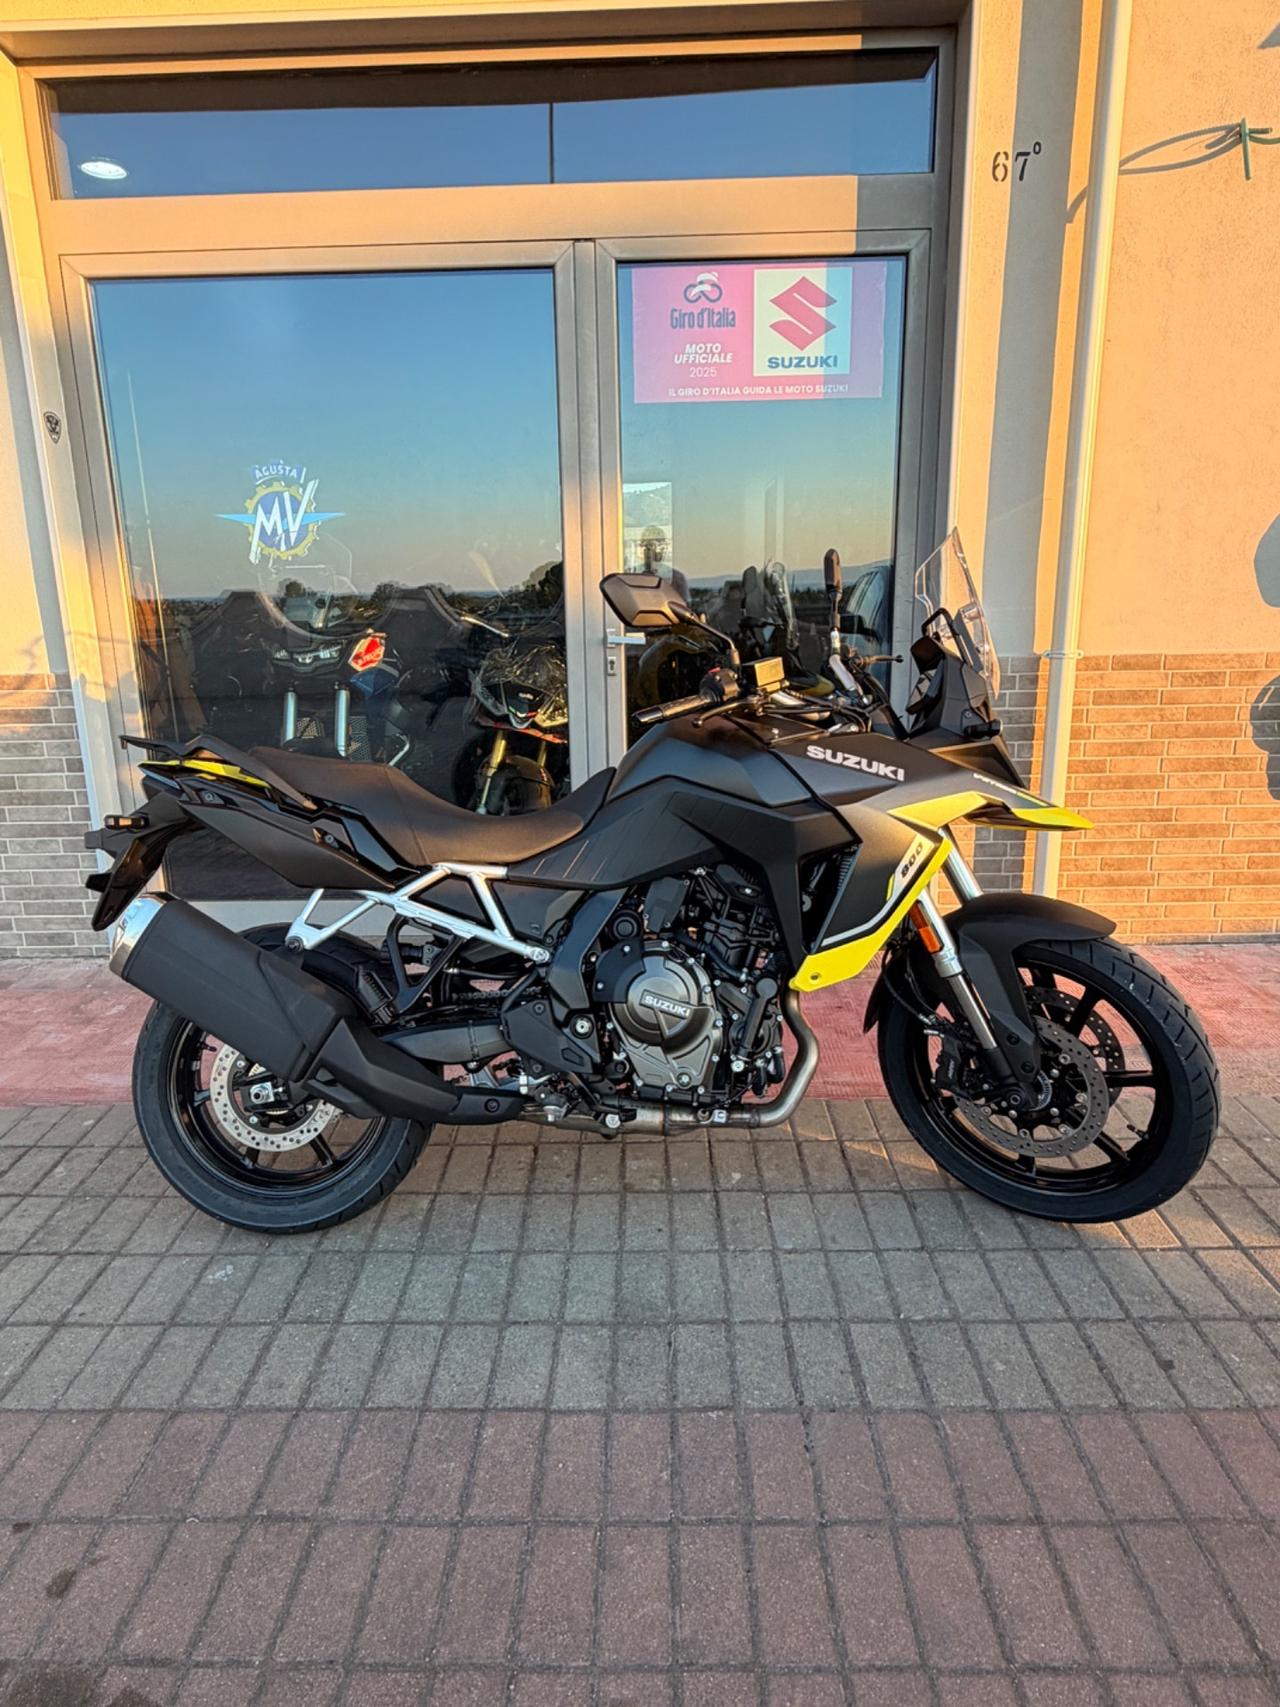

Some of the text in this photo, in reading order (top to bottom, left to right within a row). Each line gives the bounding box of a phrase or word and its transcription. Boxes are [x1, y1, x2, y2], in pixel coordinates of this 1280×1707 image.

[670, 307, 736, 329] Giro d'Italia
[685, 343, 721, 354] MOTO
[674, 352, 733, 364] UFFICIALE
[767, 355, 838, 369] SUZUKI
[689, 366, 718, 378] 2025
[668, 383, 849, 397] IL GIRO D'ITALIA GUIDA LE MOTO SUZUKI
[254, 464, 298, 479] AGUSTA
[249, 479, 319, 565] MV
[806, 745, 905, 782] SUZUKI
[901, 841, 924, 879] 800
[644, 995, 691, 1018] SUZUKI
